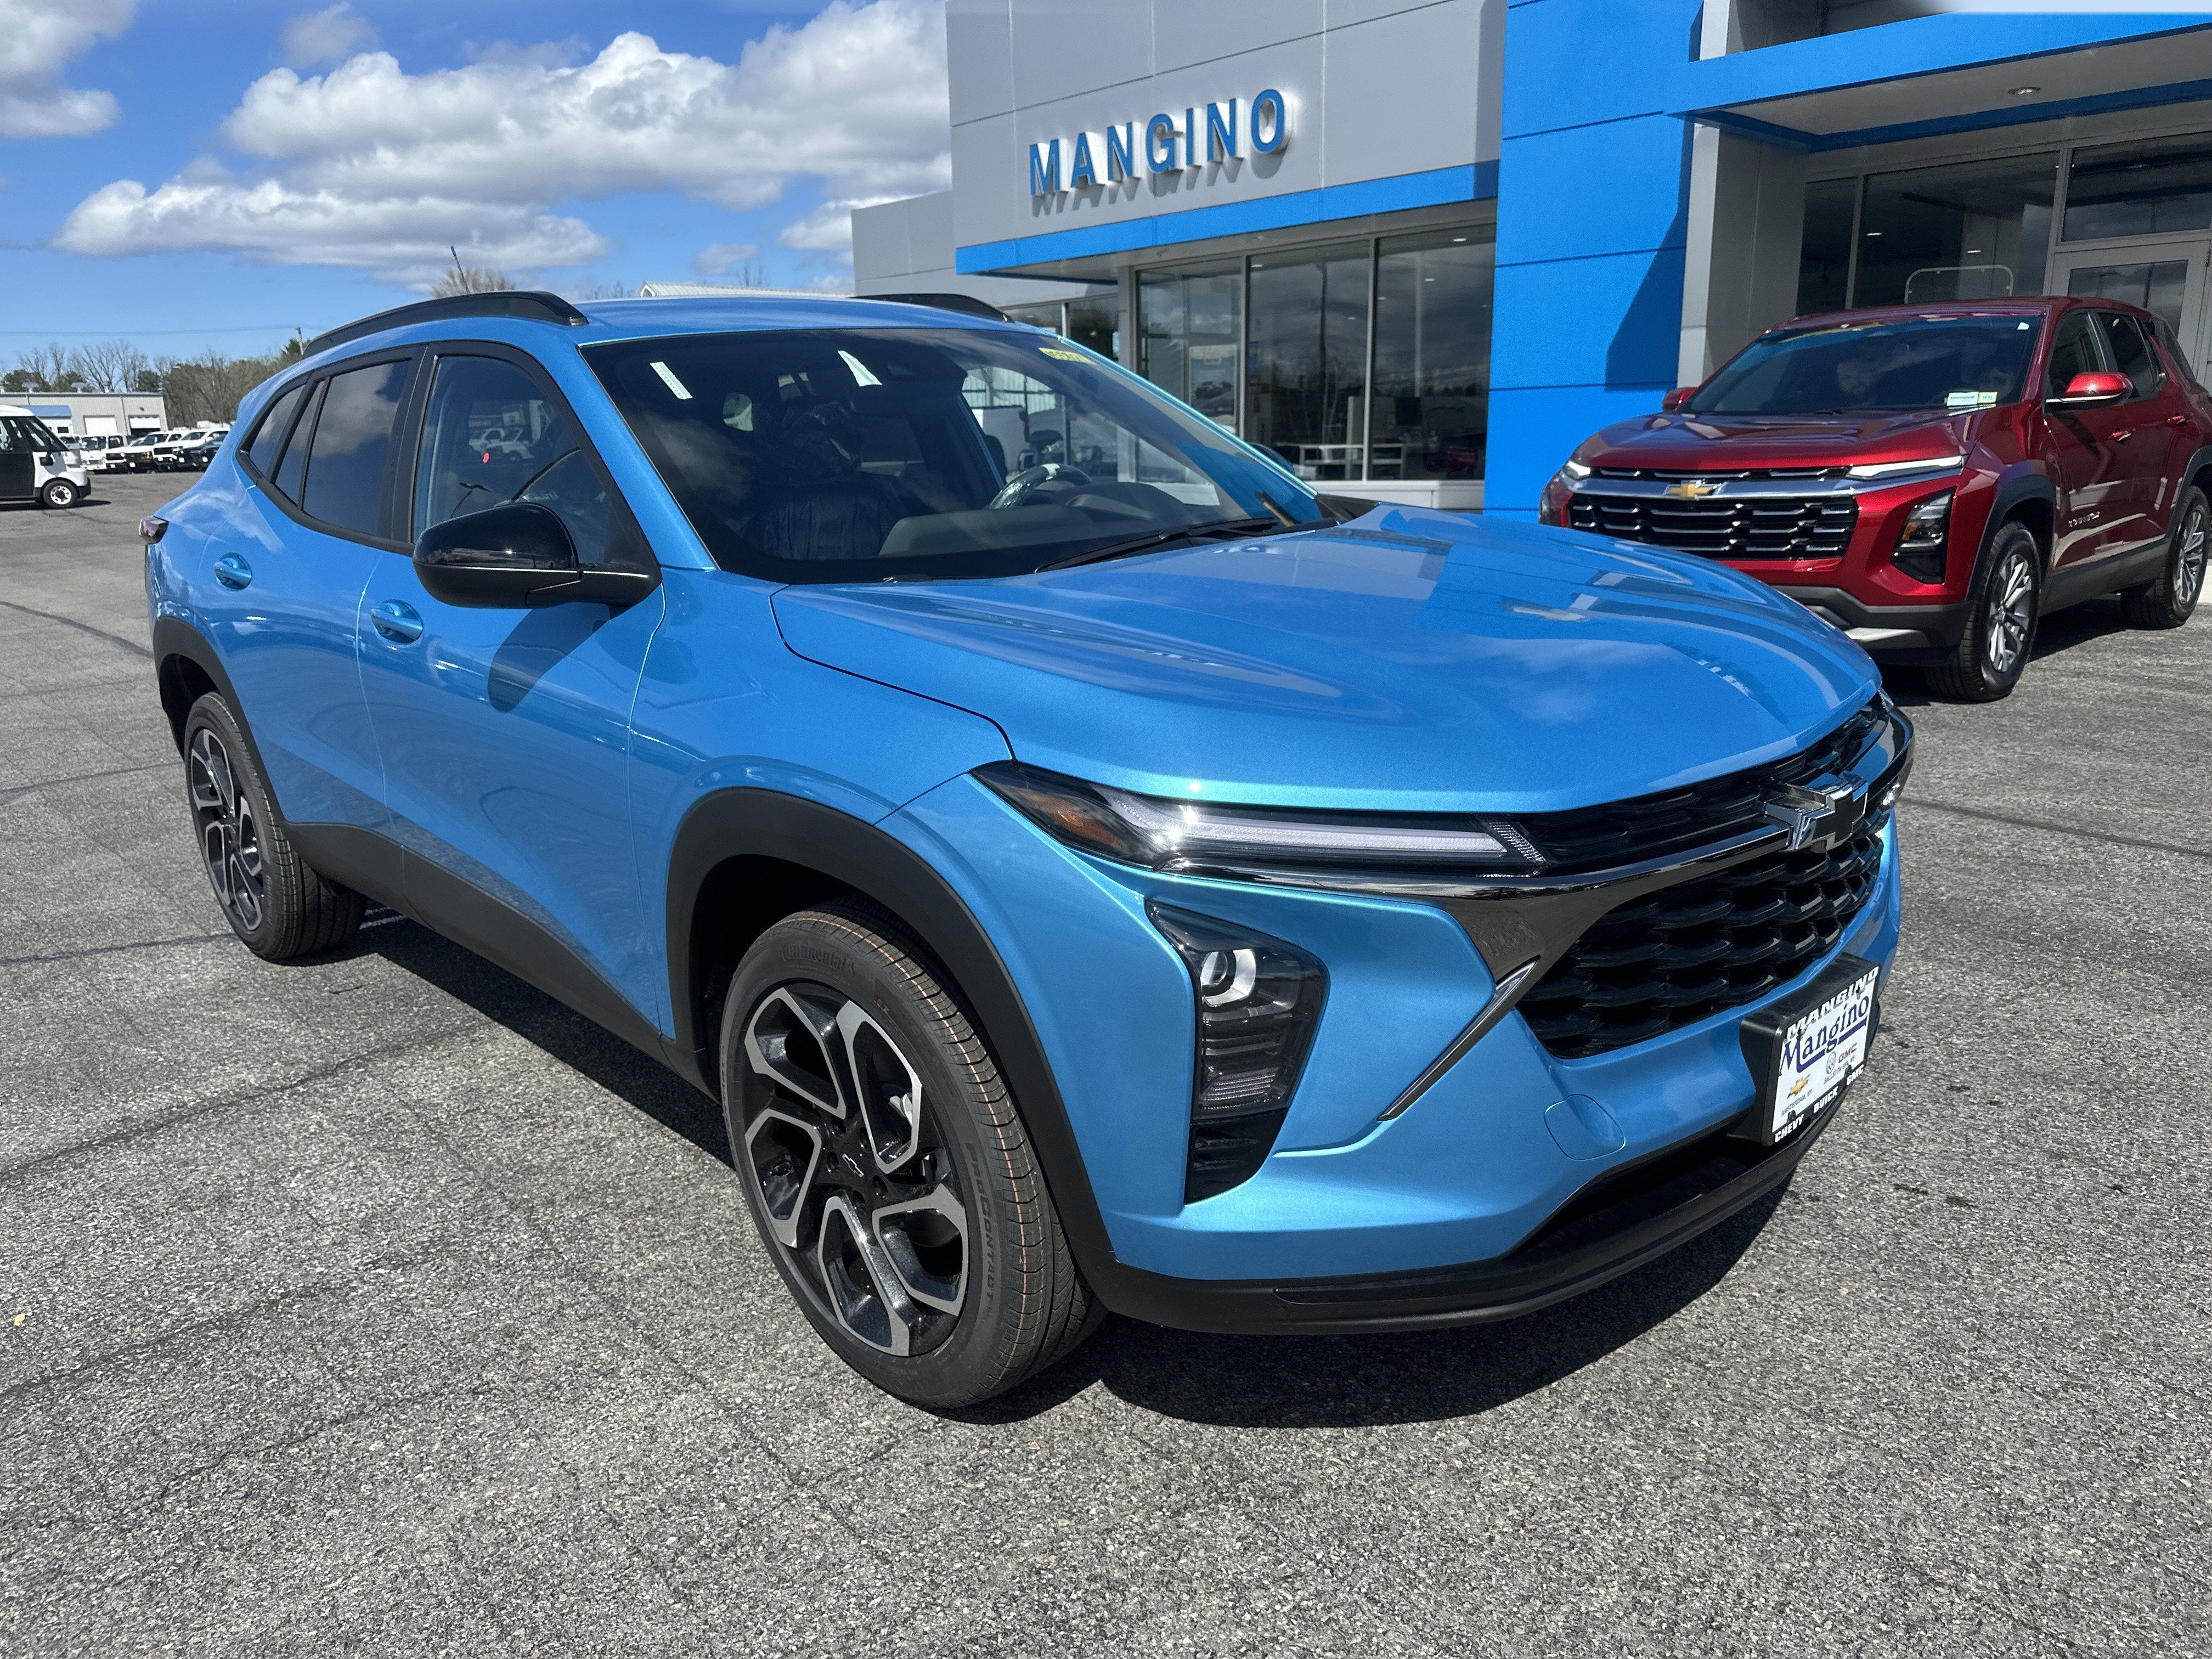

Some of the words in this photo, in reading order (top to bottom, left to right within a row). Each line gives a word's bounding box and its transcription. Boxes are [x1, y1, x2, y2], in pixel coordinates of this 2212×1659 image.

[1029, 89, 1289, 196] MANGINO
[1781, 995, 1870, 1073] Mangino
[1838, 1042, 1857, 1063] GMC
[1774, 1114, 1804, 1143] CHEVY
[1813, 1086, 1838, 1114] BUICK
[1846, 1064, 1864, 1086] GMC
